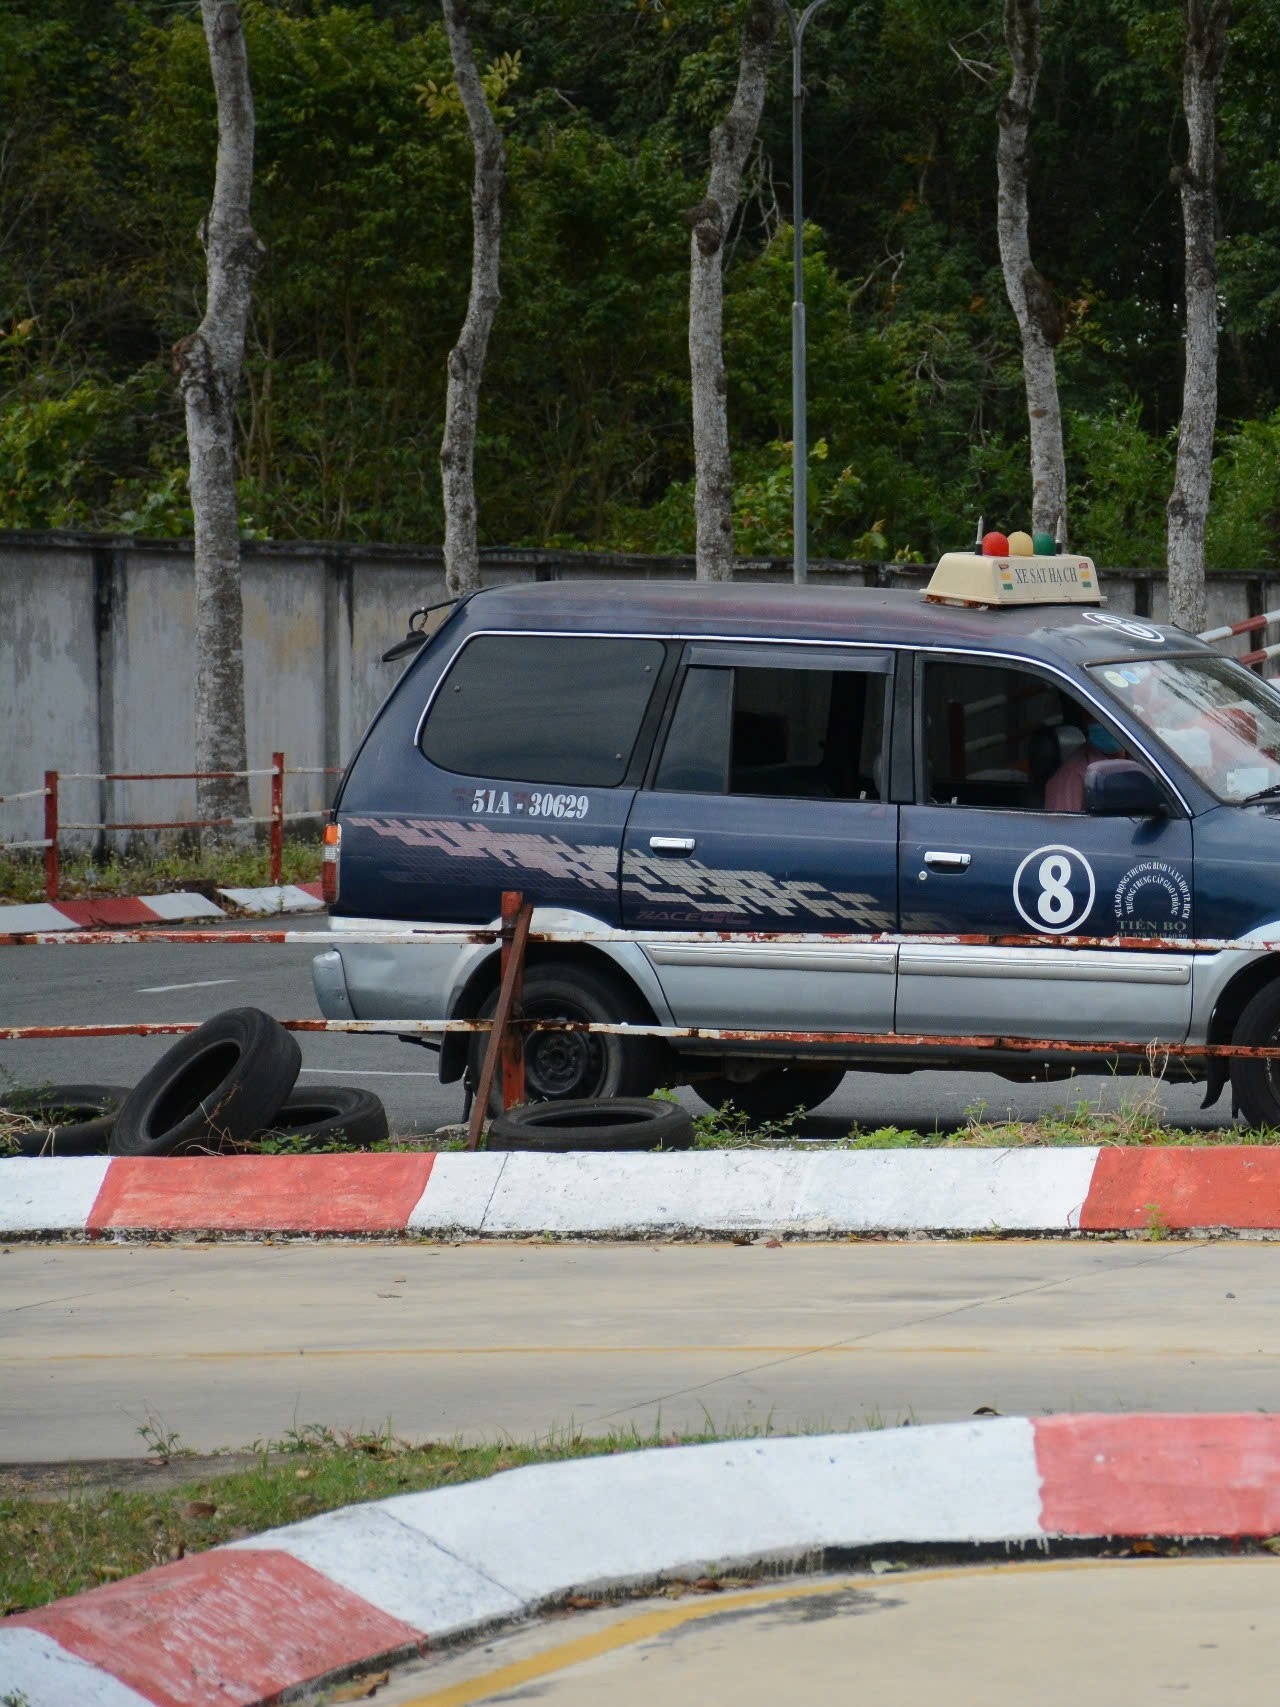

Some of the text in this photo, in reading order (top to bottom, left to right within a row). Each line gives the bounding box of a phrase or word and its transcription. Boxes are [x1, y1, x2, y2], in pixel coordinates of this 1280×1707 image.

[1015, 568, 1030, 584] XE
[1030, 564, 1048, 584] SÁT
[472, 789, 510, 814] 51A
[528, 792, 589, 819] 30629
[1037, 855, 1074, 924] 8
[1114, 894, 1122, 908] LAO
